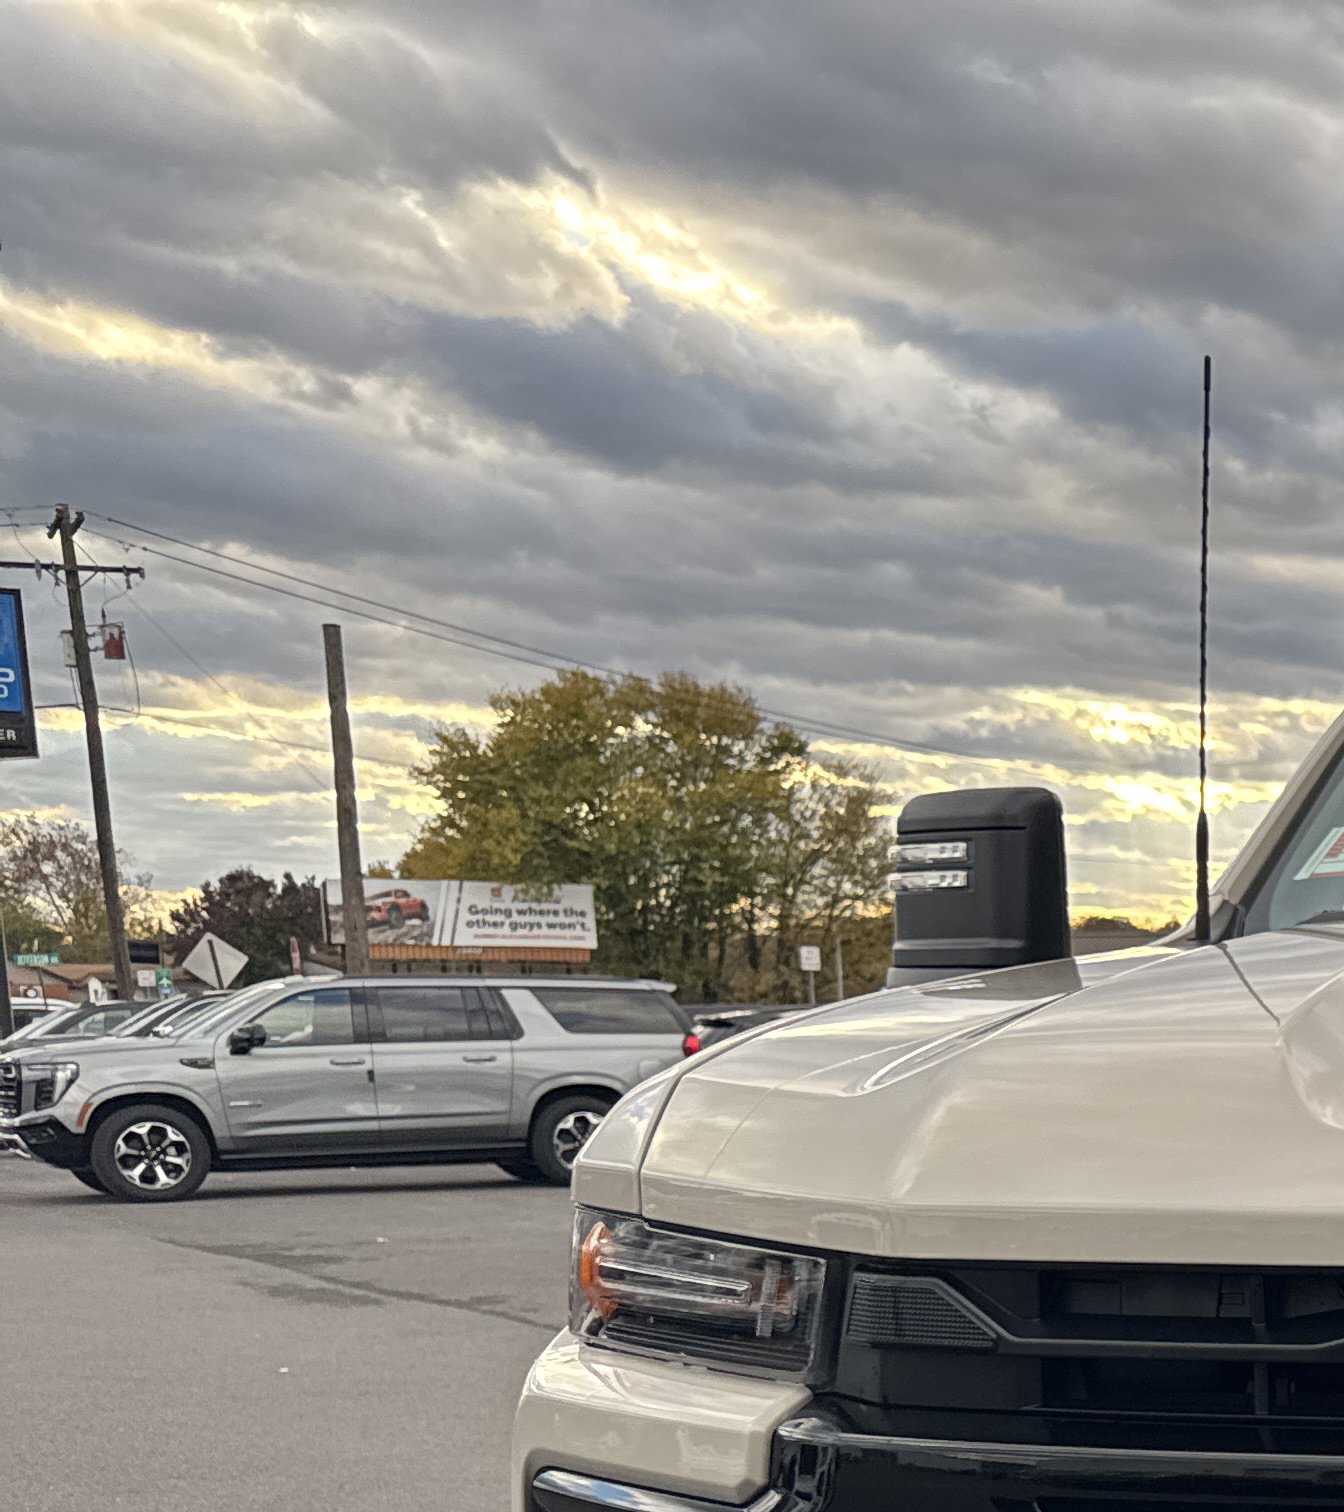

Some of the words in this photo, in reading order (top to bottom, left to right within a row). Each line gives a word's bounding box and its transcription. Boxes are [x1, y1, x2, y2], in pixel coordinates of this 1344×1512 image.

[467, 904, 512, 918] Going
[516, 905, 560, 917] where
[563, 907, 587, 918] the
[465, 918, 505, 929] other
[509, 920, 542, 932] guys
[546, 920, 591, 932] won't.
